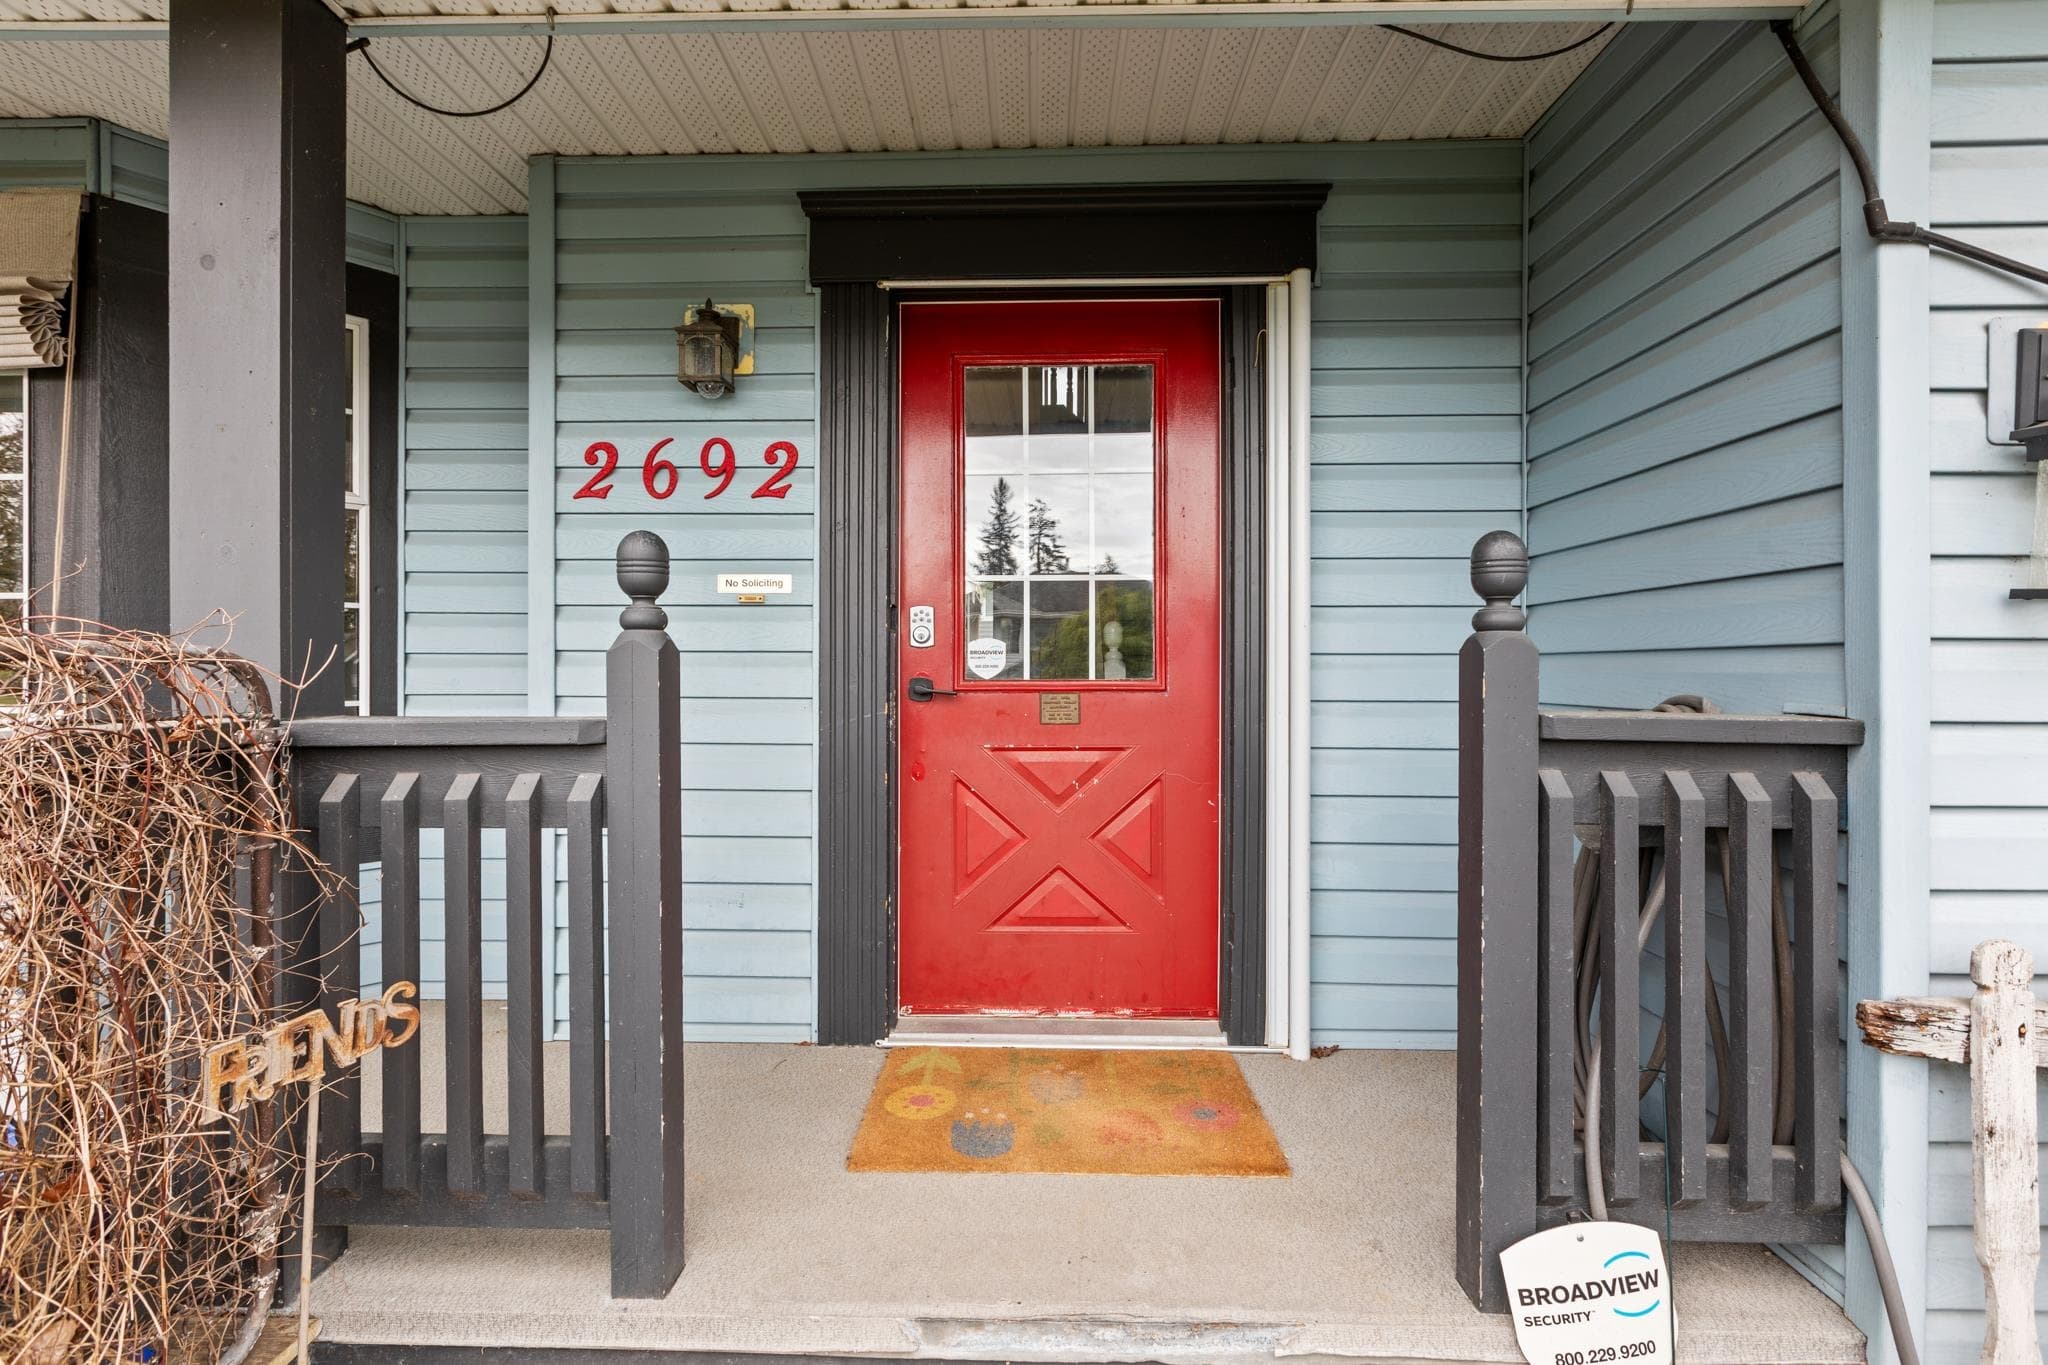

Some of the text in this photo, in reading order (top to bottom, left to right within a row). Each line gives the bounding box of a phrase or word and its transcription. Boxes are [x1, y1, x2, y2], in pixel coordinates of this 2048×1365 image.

[572, 437, 799, 500] 2692
[725, 578, 784, 589] No Soliciting
[198, 980, 420, 1126] FRIENDS
[1517, 1268, 1660, 1307] BROADVIEW
[1523, 1310, 1592, 1328] SECURITY
[1554, 1339, 1656, 1365] 800.229.9200
